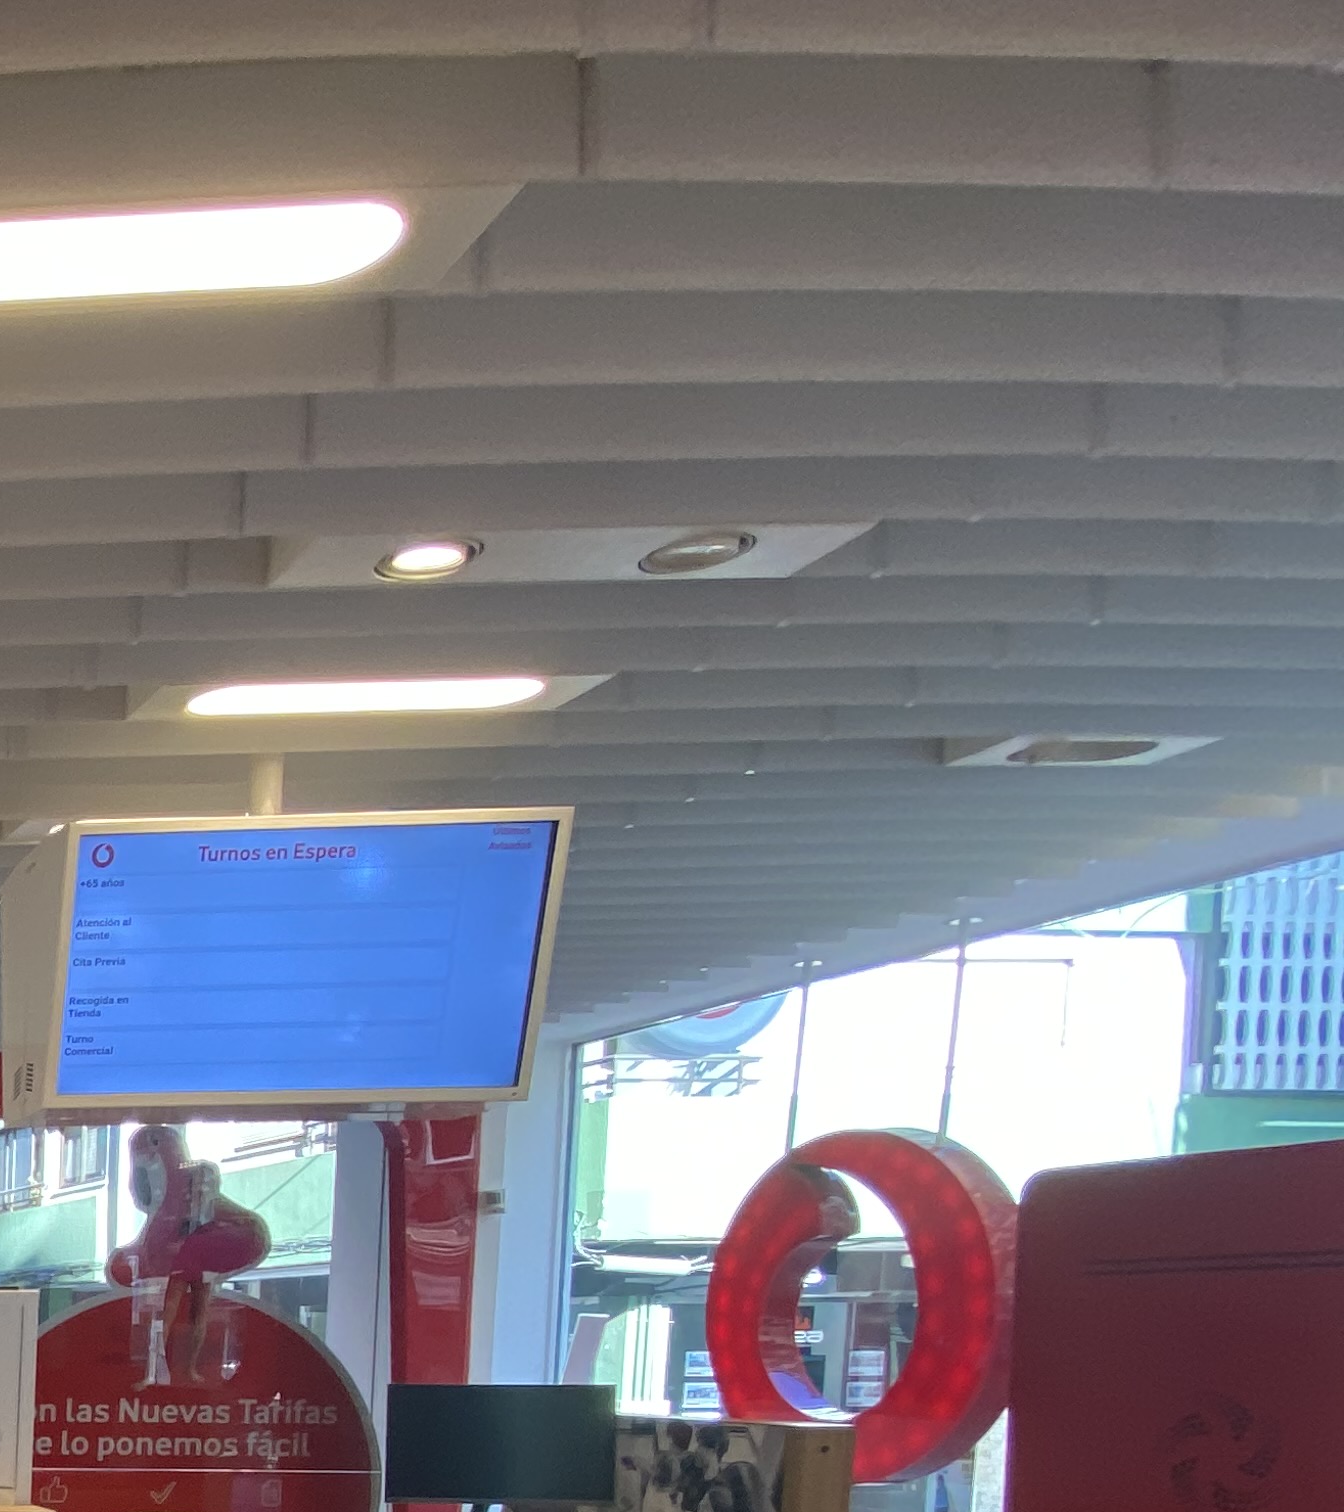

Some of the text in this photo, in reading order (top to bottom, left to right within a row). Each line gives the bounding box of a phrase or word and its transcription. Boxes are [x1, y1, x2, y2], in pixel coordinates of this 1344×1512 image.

[199, 843, 357, 862] Turnos en Espera
[76, 918, 121, 928] Atención
[75, 931, 110, 940] Cliente
[72, 957, 126, 967] Cita Previa
[69, 996, 114, 1007] Recogida
[69, 1009, 101, 1017] Tienda
[66, 1035, 94, 1044] Turno
[64, 1047, 114, 1056] Comercial
[34, 1397, 338, 1425] n las Nuevas Tarifas
[60, 1429, 89, 1456] lo
[96, 1433, 239, 1462] ponemos
[246, 1430, 311, 1458] fácil
